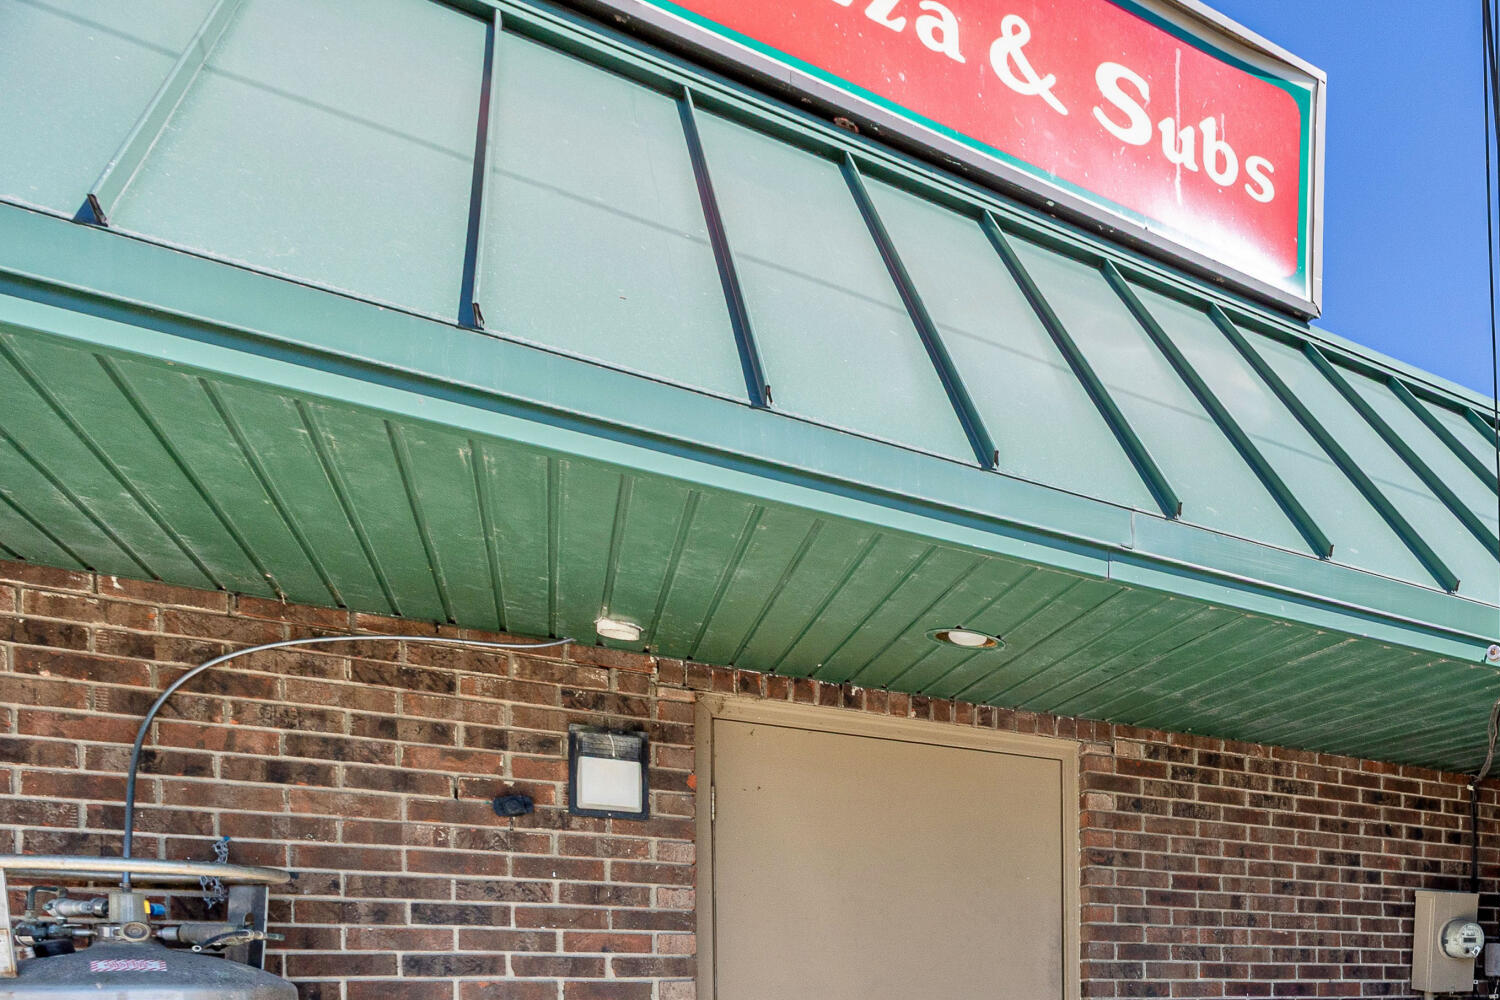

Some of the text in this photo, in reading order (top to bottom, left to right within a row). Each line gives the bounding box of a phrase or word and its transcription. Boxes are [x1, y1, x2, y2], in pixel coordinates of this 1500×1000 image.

[831, 0, 1276, 204] za & Subs
